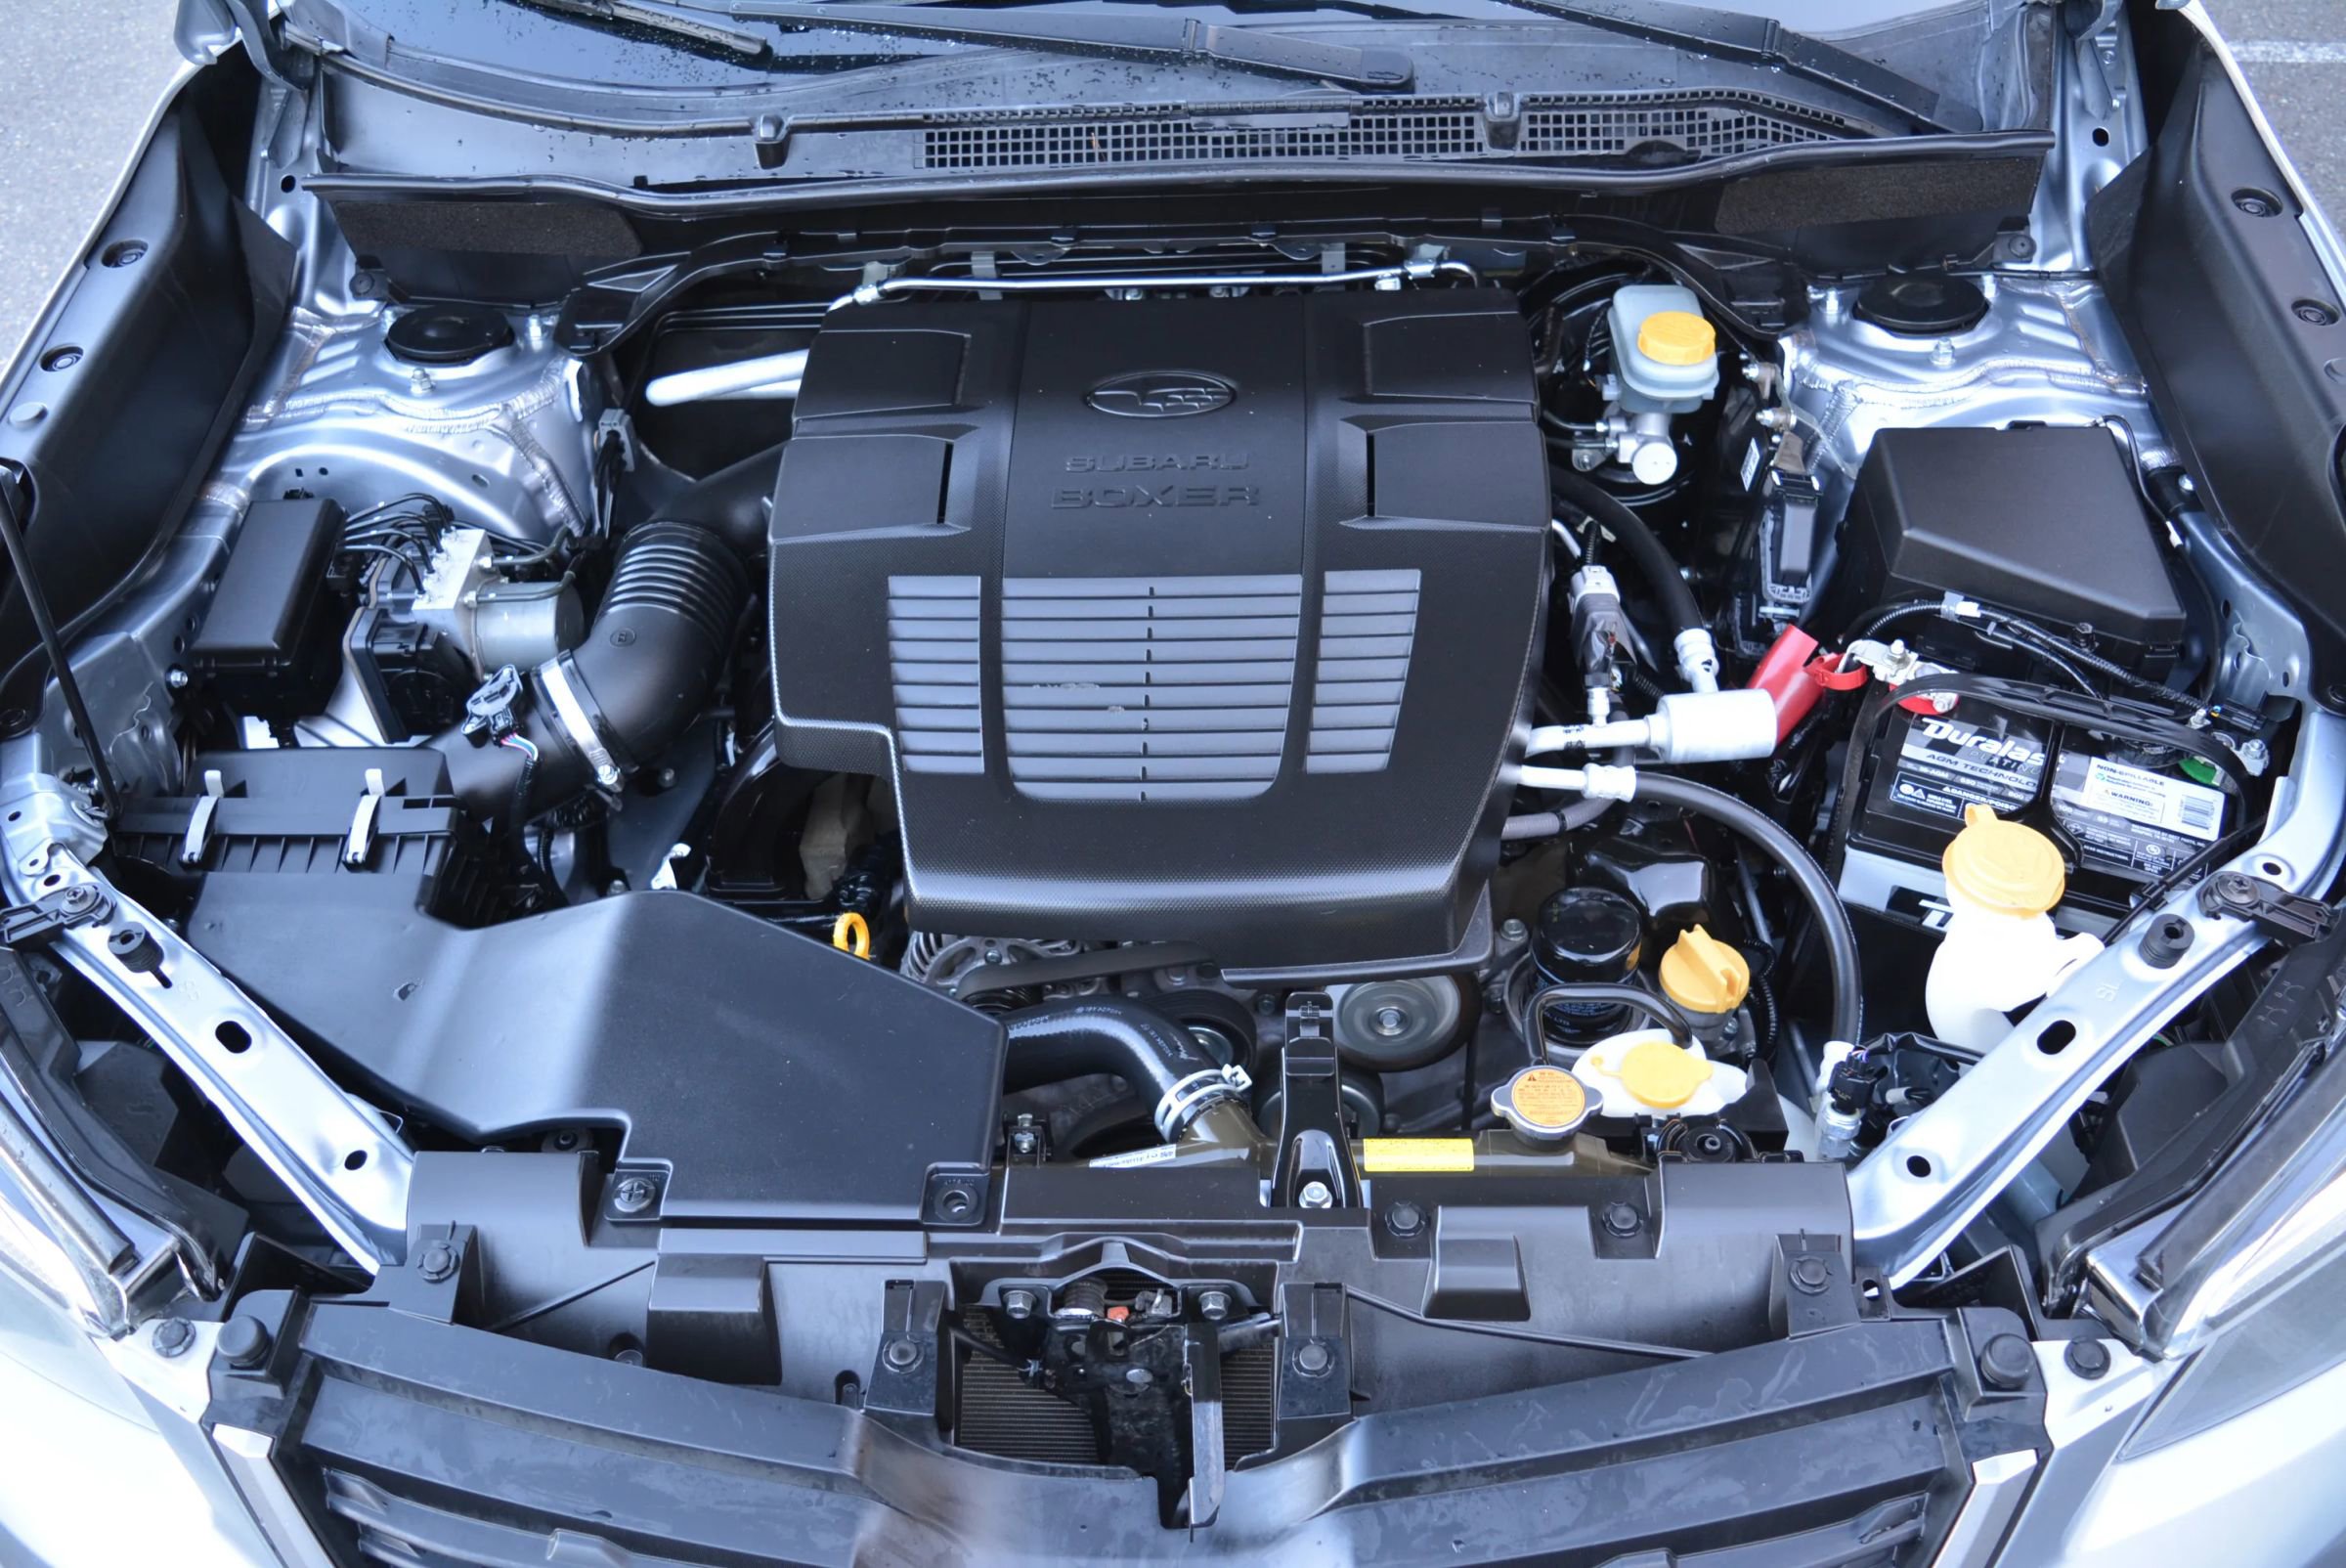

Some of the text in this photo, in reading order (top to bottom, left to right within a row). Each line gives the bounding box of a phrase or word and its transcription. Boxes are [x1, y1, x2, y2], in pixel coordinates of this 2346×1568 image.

[1065, 454, 1249, 472] SUBARU
[1051, 485, 1260, 508] BOXER
[1922, 717, 2045, 766] Duralas
[1927, 753, 1958, 766] AGM
[1963, 763, 2037, 788] TECHNOLO
[1968, 751, 2042, 775] PLATINU
